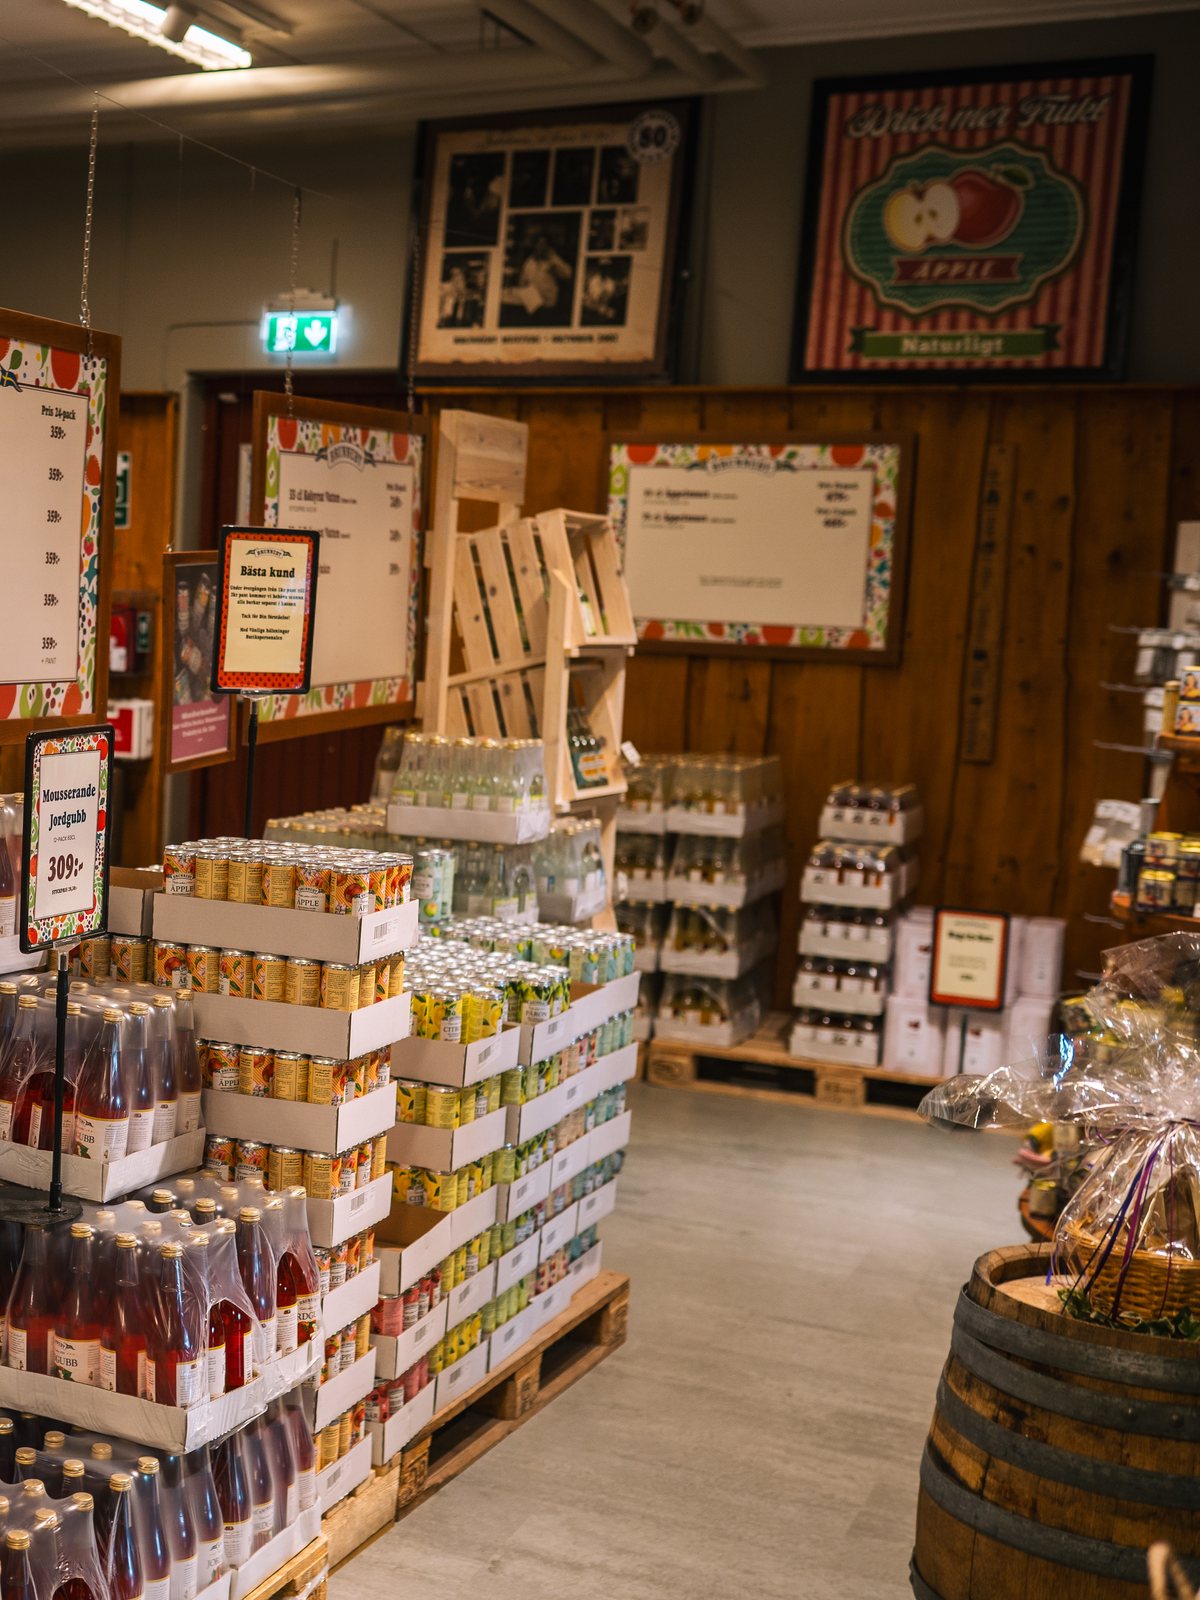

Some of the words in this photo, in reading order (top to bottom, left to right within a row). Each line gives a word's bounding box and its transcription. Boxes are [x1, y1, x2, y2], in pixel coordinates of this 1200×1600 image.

[41, 405, 54, 417] Pris
[240, 565, 267, 577] Bästa
[269, 566, 296, 579] kund
[42, 783, 96, 803] Mousserande
[48, 808, 87, 832] Jordgubb
[47, 853, 84, 882] 309:-
[170, 883, 194, 893] ÄPPLE
[296, 897, 320, 907] ÄPPLE
